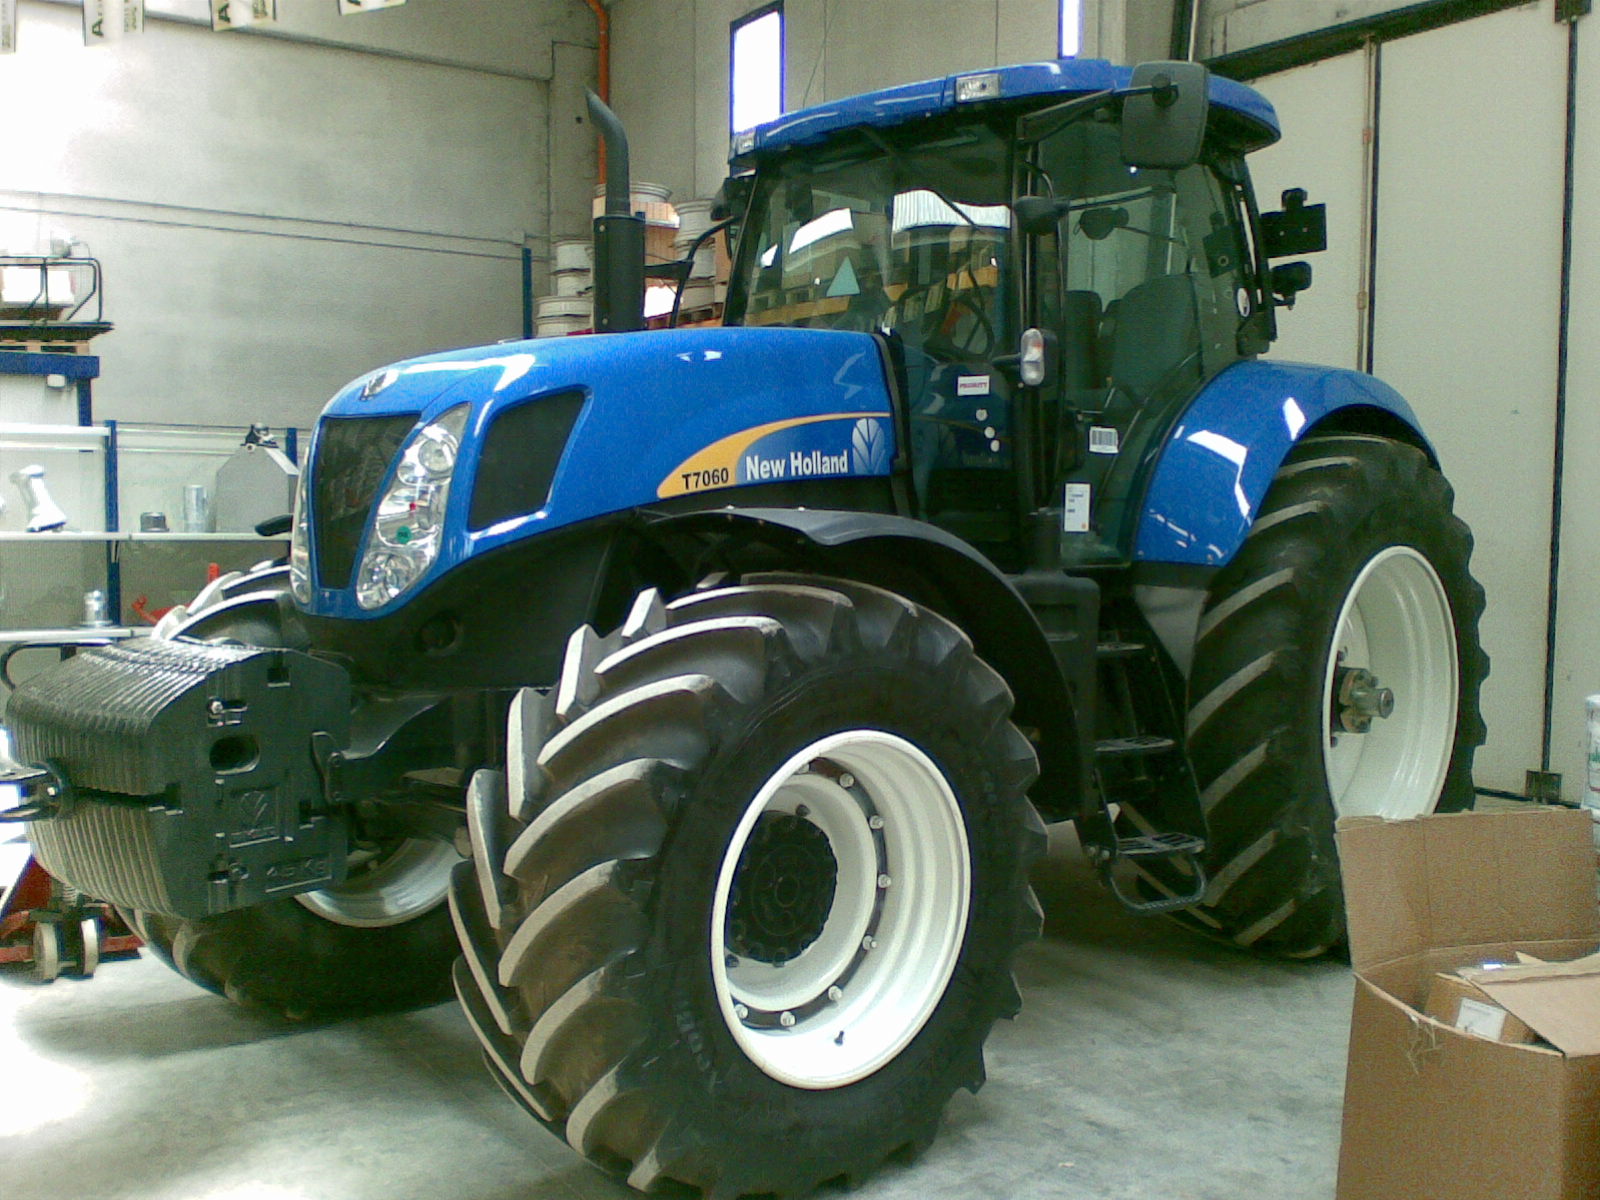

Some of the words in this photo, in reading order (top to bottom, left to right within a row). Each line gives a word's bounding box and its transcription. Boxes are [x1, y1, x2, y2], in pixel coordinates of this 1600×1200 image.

[682, 467, 729, 490] T7060
[745, 455, 786, 481] New
[790, 450, 848, 475] Holland
